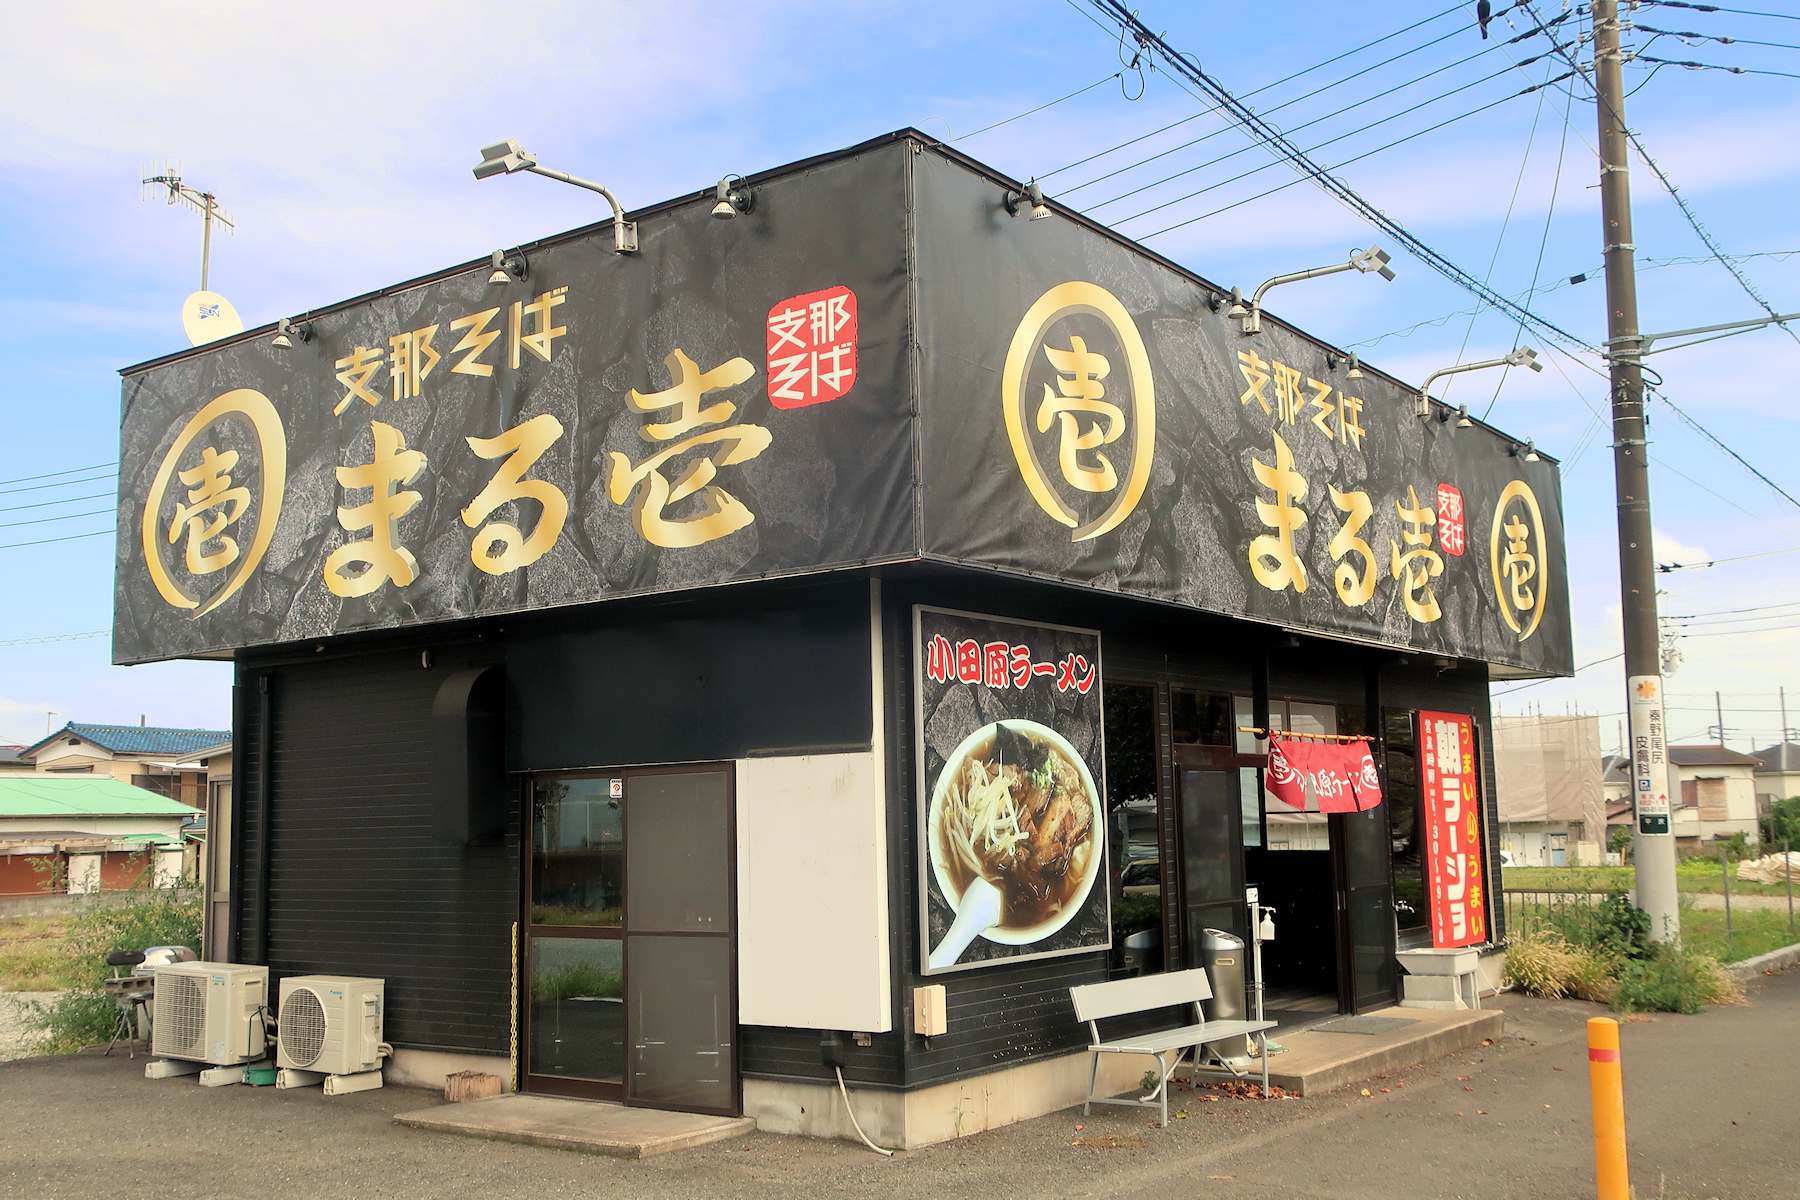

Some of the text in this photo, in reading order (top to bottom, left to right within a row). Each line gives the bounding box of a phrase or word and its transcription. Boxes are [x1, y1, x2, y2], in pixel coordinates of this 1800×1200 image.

[199, 306, 220, 318] SUN
[333, 286, 570, 417] 支那そば
[768, 293, 853, 355] 支那
[769, 344, 853, 401] そば
[1036, 335, 1126, 491] 壱
[1237, 348, 1367, 450] 支那そば
[168, 446, 252, 575] 壱
[323, 347, 773, 598] まる壱
[1437, 488, 1462, 520] 支那
[1248, 430, 1444, 623] まる壱
[1438, 518, 1464, 552] そば
[1503, 514, 1536, 611] 壱
[927, 633, 1096, 694] 小田原ラーメン
[1650, 709, 1664, 764] 秦野尾尻
[1461, 722, 1483, 937] うまい うまい
